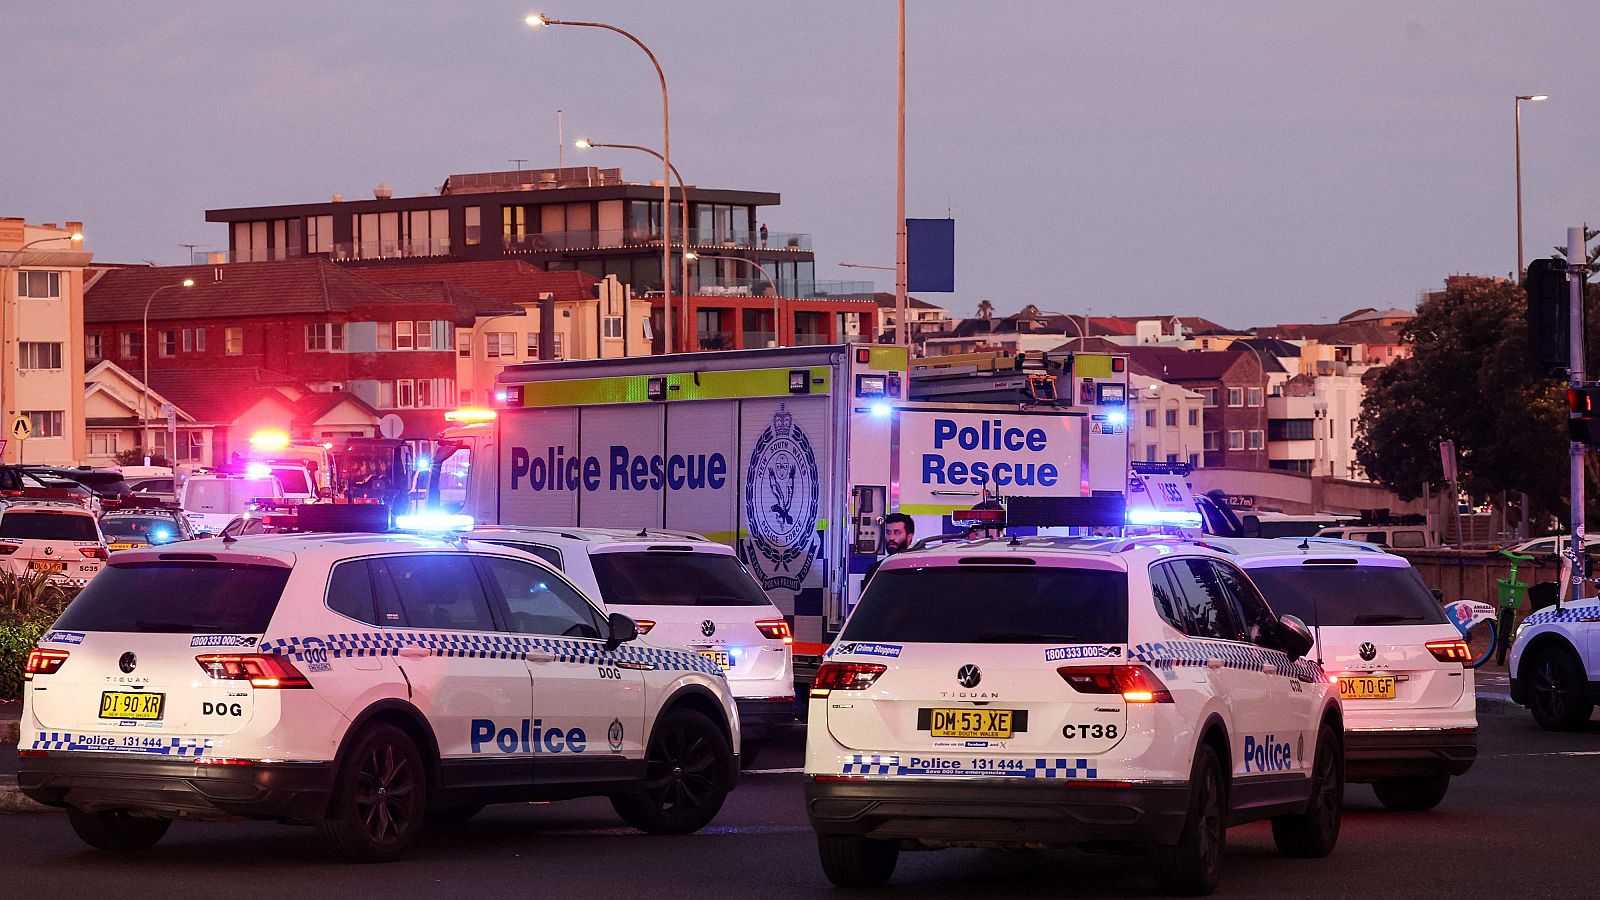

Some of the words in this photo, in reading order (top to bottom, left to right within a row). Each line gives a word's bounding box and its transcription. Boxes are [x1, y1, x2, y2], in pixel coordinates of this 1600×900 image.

[934, 418, 1047, 452] Police
[770, 441, 788, 454] SOUTH
[511, 445, 601, 492] Police
[609, 445, 727, 491] Rescue
[921, 453, 1059, 487] Rescue
[761, 520, 779, 544] POLICE
[785, 520, 802, 544] FORCE
[191, 635, 208, 647] 1800
[208, 635, 223, 646] 333
[223, 635, 236, 646] 000
[304, 647, 328, 664] 000
[856, 643, 874, 653] Crime
[873, 645, 900, 656] Stoppers
[1046, 648, 1066, 660] 1800
[1066, 647, 1082, 658] 333
[1082, 646, 1098, 657] 000
[598, 666, 622, 680] DOG
[1340, 680, 1356, 694] DK
[1359, 679, 1374, 694] 70
[1378, 679, 1392, 694] GF
[103, 694, 119, 712] DI
[124, 695, 139, 713] 90
[142, 696, 159, 713] XR
[202, 701, 242, 717] DOG
[934, 711, 955, 731] DM
[961, 712, 982, 731] 53
[988, 712, 1009, 732] XE
[470, 718, 587, 754] Police
[1062, 724, 1118, 739] CT38
[78, 734, 115, 746] Police
[122, 736, 140, 747] 131
[141, 737, 162, 748] 444
[1243, 734, 1292, 773] Police
[910, 757, 961, 769] Police
[971, 758, 994, 769] 131
[997, 759, 1024, 770] 444
